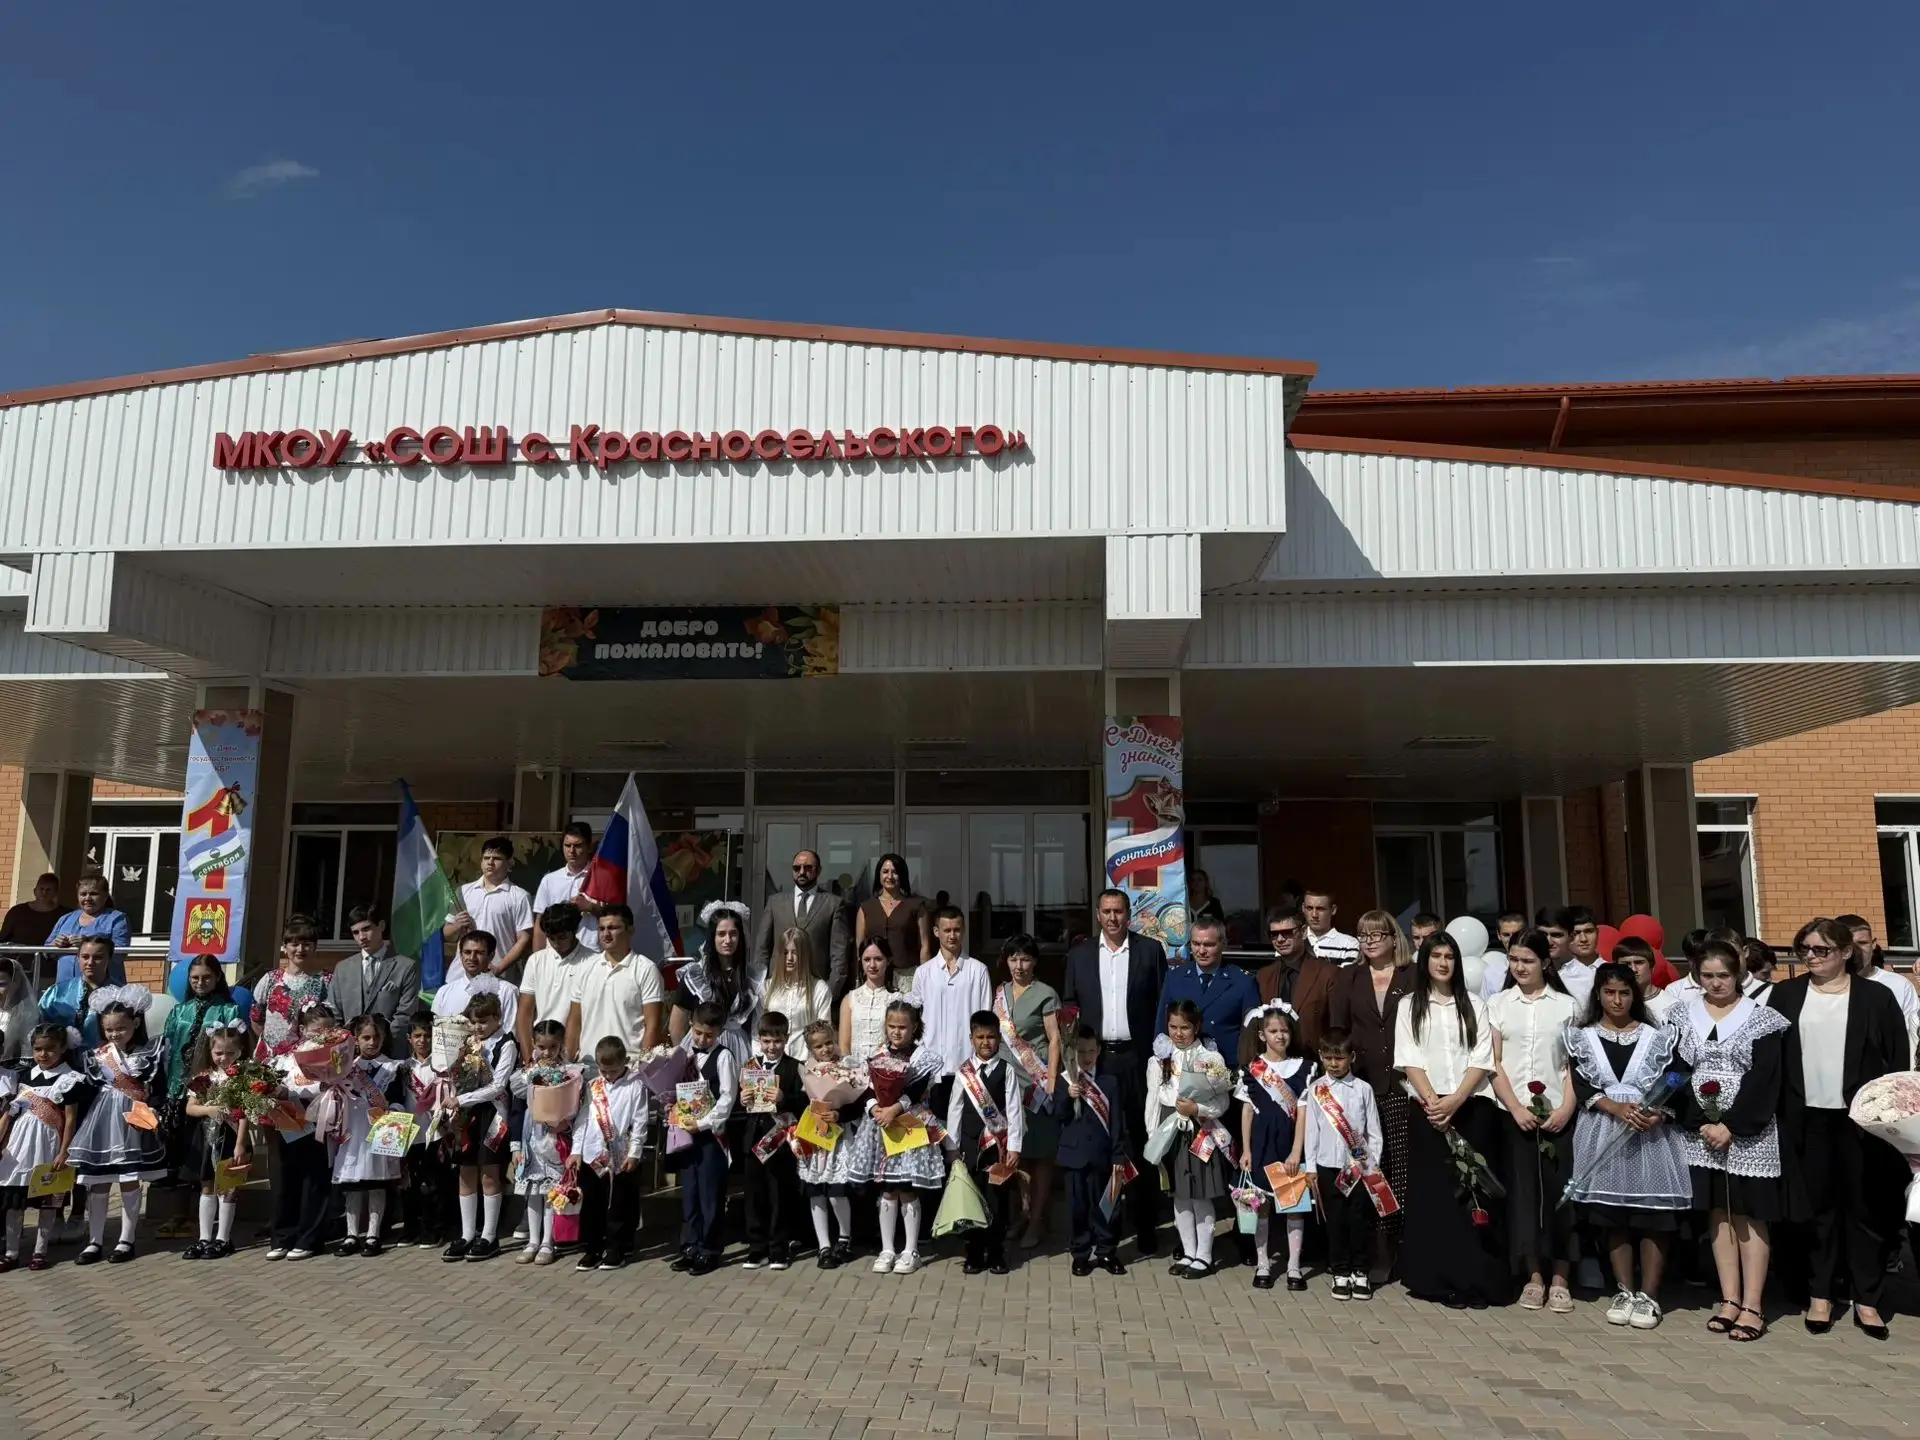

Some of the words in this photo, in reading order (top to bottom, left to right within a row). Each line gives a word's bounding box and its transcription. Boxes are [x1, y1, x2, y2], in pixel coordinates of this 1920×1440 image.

[213, 428, 353, 470] МКОУ
[362, 425, 509, 466] «СОШ
[520, 432, 556, 464] с.
[570, 423, 1026, 471] Красносельского»
[640, 620, 719, 637] ДОБРО
[595, 642, 763, 660] ПОЖАЛОВАТЬ!
[1105, 726, 1121, 746] С
[198, 852, 240, 878] сентября
[1115, 840, 1176, 867] сентября
